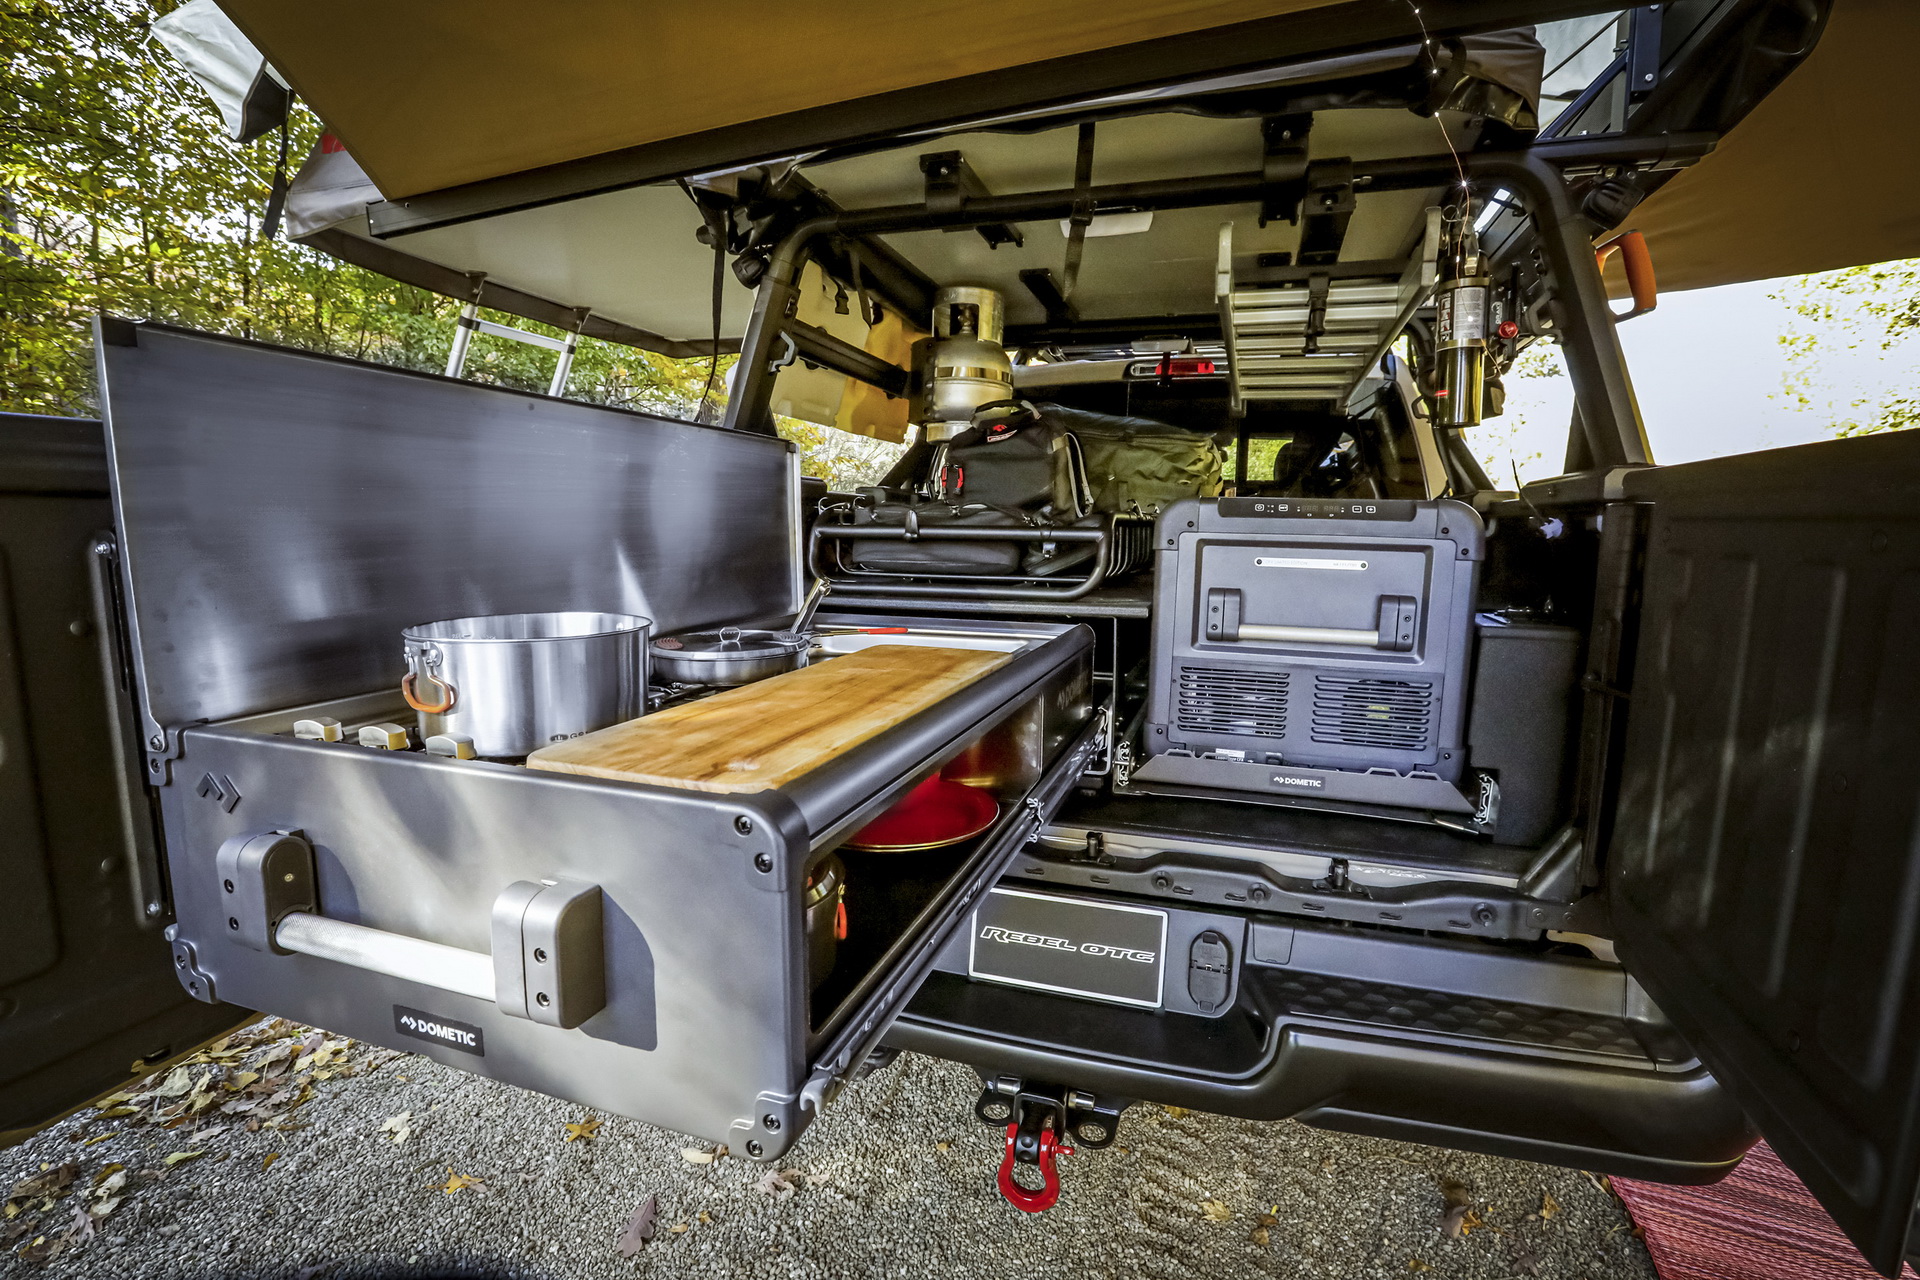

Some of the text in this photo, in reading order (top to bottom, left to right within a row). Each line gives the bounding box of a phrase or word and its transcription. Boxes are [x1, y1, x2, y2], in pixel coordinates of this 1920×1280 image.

[1284, 777, 1322, 788] DOMETIC
[980, 925, 1156, 964] REBEL OTG
[417, 1019, 477, 1047] DOMETIC
